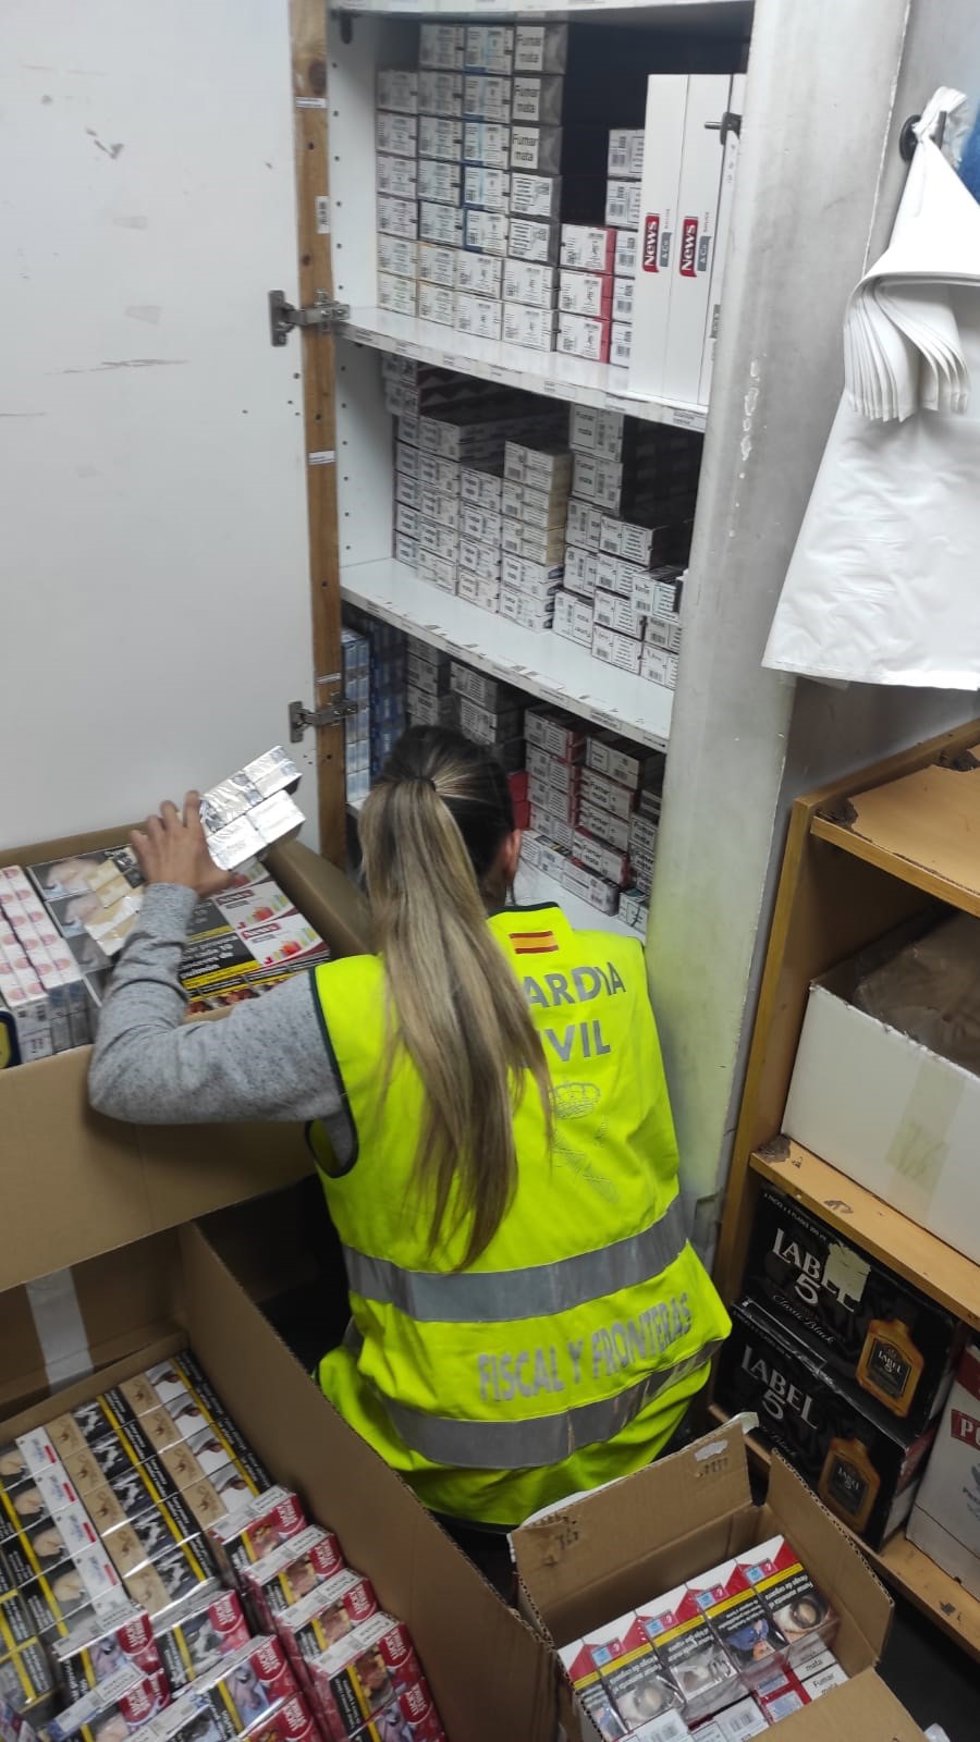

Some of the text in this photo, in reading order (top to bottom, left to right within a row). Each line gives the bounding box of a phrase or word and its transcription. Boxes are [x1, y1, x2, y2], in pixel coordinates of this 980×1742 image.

[513, 133, 536, 146] Fumar
[515, 151, 534, 161] mata
[521, 961, 626, 1008] ARDIA
[544, 1020, 612, 1062] VIL
[793, 1272, 821, 1305] 5
[477, 1346, 565, 1401] FISCAL
[567, 1338, 583, 1385] Y
[591, 1292, 692, 1379] FRONTERAS
[741, 1344, 819, 1430] LABEL
[761, 1394, 787, 1421] 5
[804, 1657, 823, 1671] mata
[812, 1672, 835, 1688] Fumar
